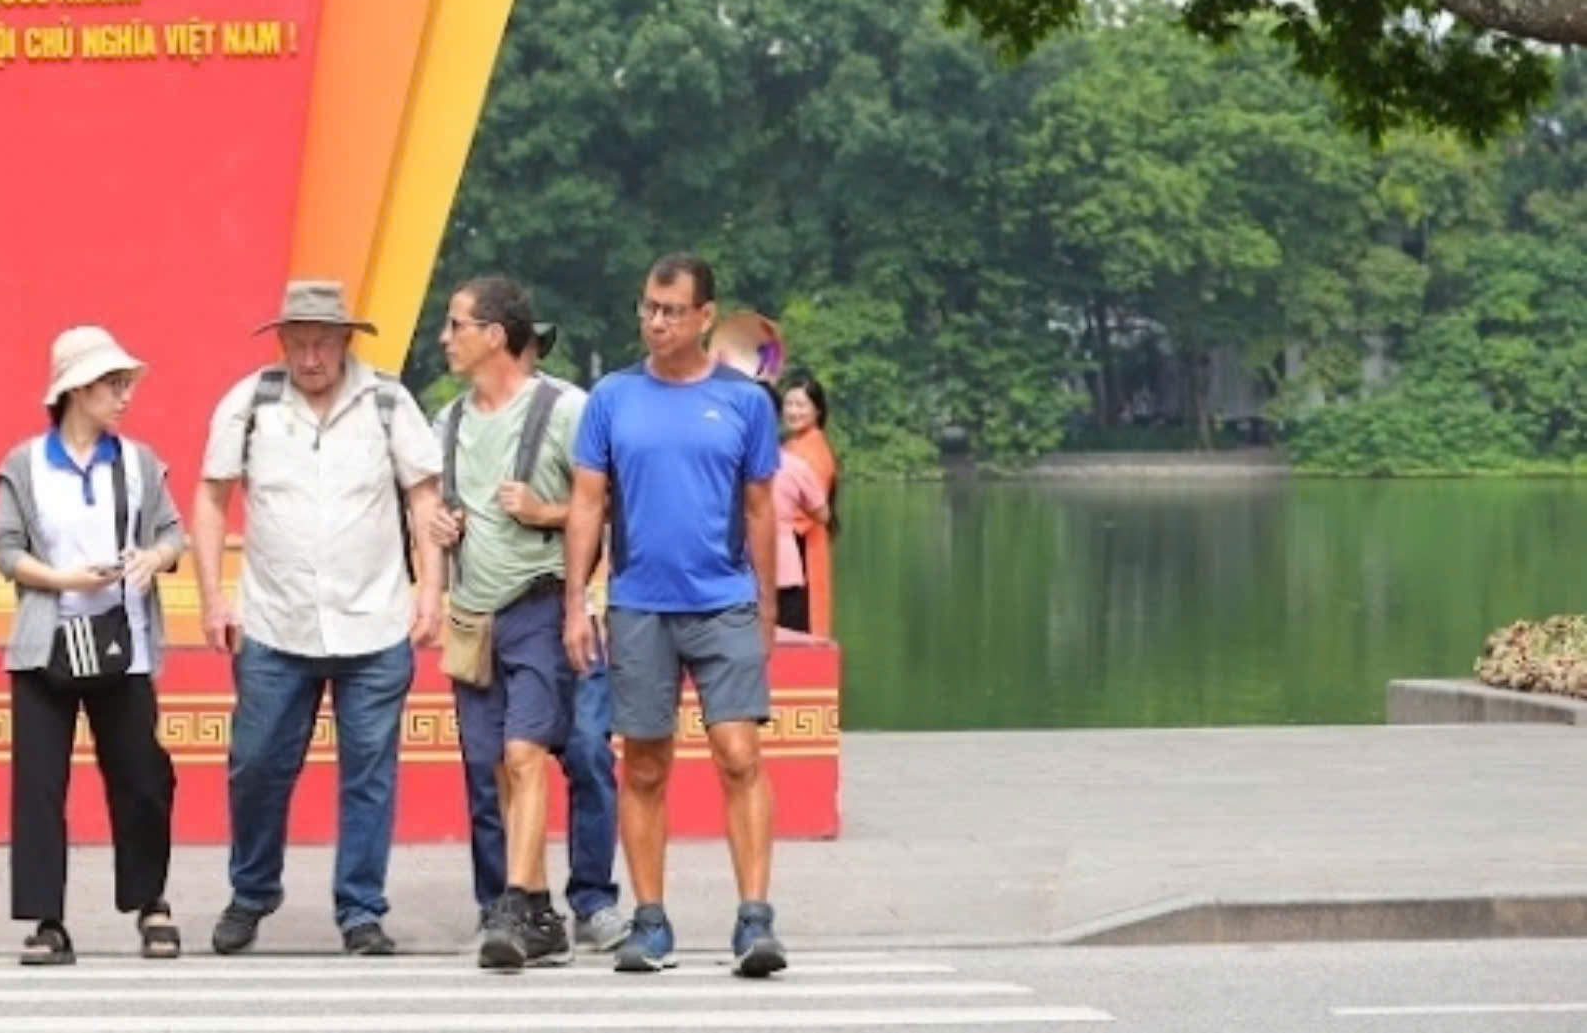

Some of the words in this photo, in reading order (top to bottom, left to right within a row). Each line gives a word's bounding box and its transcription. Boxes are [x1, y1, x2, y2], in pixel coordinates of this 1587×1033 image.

[24, 14, 74, 59] CHỦ
[165, 15, 215, 63] VIỆT
[222, 20, 281, 56] NAM
